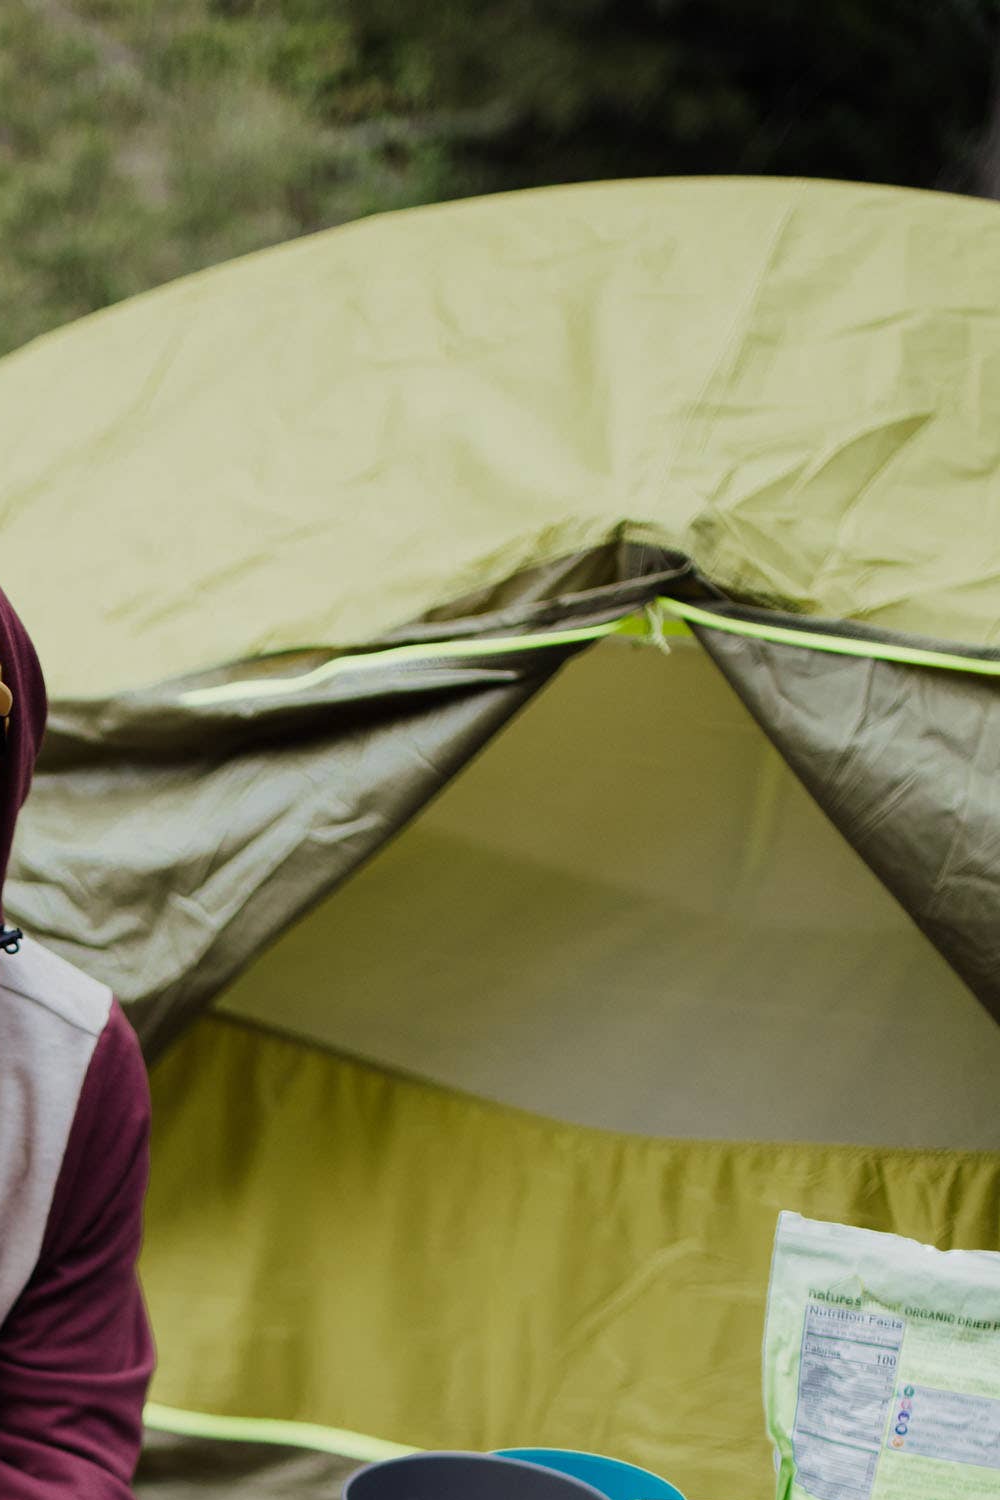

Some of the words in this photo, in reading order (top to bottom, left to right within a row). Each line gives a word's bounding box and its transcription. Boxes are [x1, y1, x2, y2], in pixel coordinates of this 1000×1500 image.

[808, 1288, 862, 1307] natures
[809, 1306, 864, 1323] Nutrition
[869, 1314, 902, 1329] Facts
[904, 1306, 955, 1324] ORGANIC
[957, 1316, 991, 1330] DRIED
[877, 1354, 897, 1367] 100
